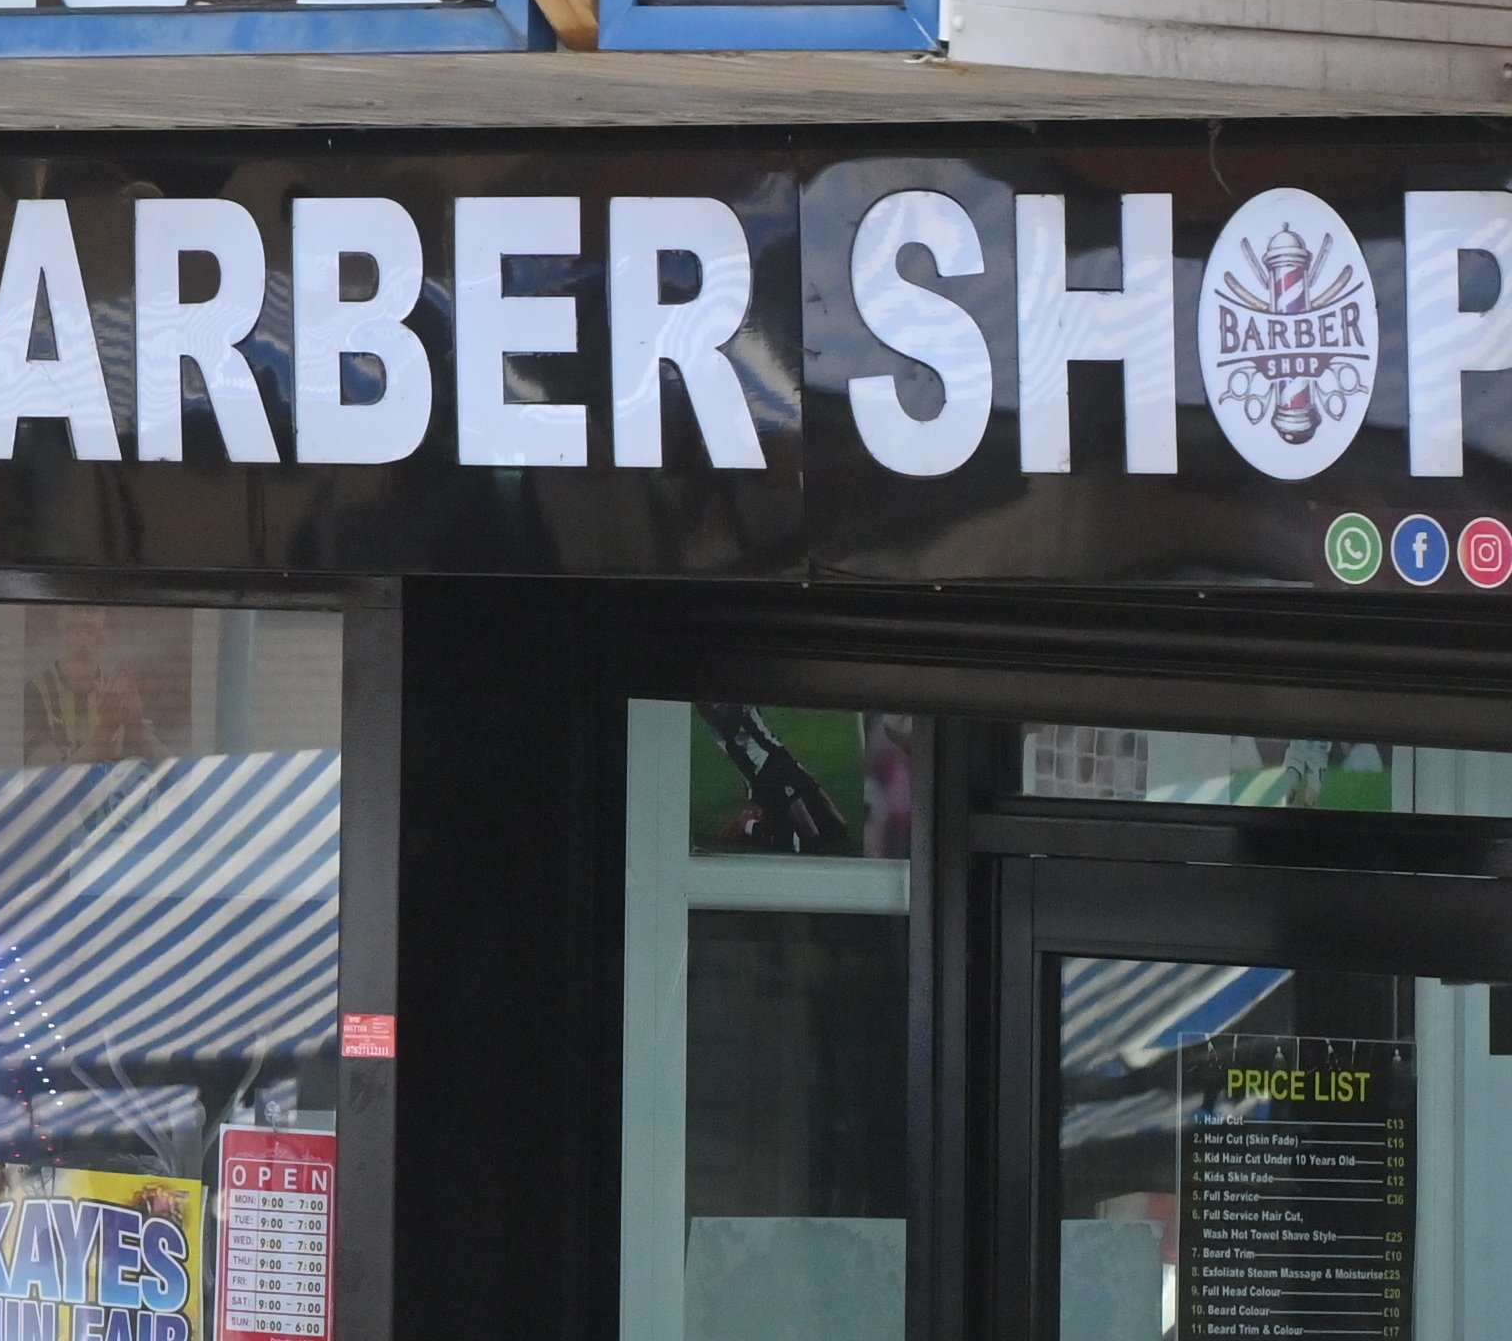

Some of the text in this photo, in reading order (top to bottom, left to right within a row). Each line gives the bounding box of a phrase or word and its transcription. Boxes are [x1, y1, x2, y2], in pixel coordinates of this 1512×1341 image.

[1218, 301, 1365, 354] BARBER
[1267, 358, 1319, 376] SHOP
[1227, 1068, 1371, 1103] PRICE LIST
[1204, 1115, 1224, 1125] Hair
[1226, 1116, 1244, 1126] Cut
[1204, 1134, 1224, 1145] Hair
[1226, 1135, 1243, 1145] Cut
[1204, 1153, 1220, 1164] Kid
[1222, 1154, 1242, 1164] Hair
[1245, 1154, 1261, 1165] Cut
[1264, 1154, 1292, 1165] Under
[1296, 1155, 1306, 1166] 10
[1310, 1156, 1336, 1166] Years
[1339, 1156, 1355, 1167] Old
[232, 1165, 327, 1191] OPEN
[1204, 1172, 1225, 1183] Kids
[1228, 1172, 1249, 1183] Skin
[1251, 1173, 1274, 1184] Fade
[1204, 1191, 1260, 1203] Full Service
[262, 1197, 284, 1208] 9:00
[299, 1199, 324, 1211] 7:00
[1203, 1210, 1220, 1221] Full
[1223, 1211, 1259, 1222] Service
[1261, 1211, 1281, 1222] Hair
[261, 1218, 283, 1228] 9:00
[297, 1220, 322, 1230] 7:00
[1203, 1229, 1337, 1244] Wash Hot Towel Shave Style
[260, 1239, 282, 1249] 9:00
[297, 1241, 323, 1252] 7:00
[260, 1259, 282, 1270] 9:00
[297, 1261, 322, 1272] 7:00
[259, 1280, 281, 1290] 9:00
[297, 1282, 321, 1292] 7:00
[1202, 1286, 1281, 1298] Full Head Colour
[259, 1300, 281, 1310] 9:00
[297, 1302, 321, 1313] 7:00
[256, 1320, 282, 1331] 10:00
[295, 1322, 320, 1333] 6:00
